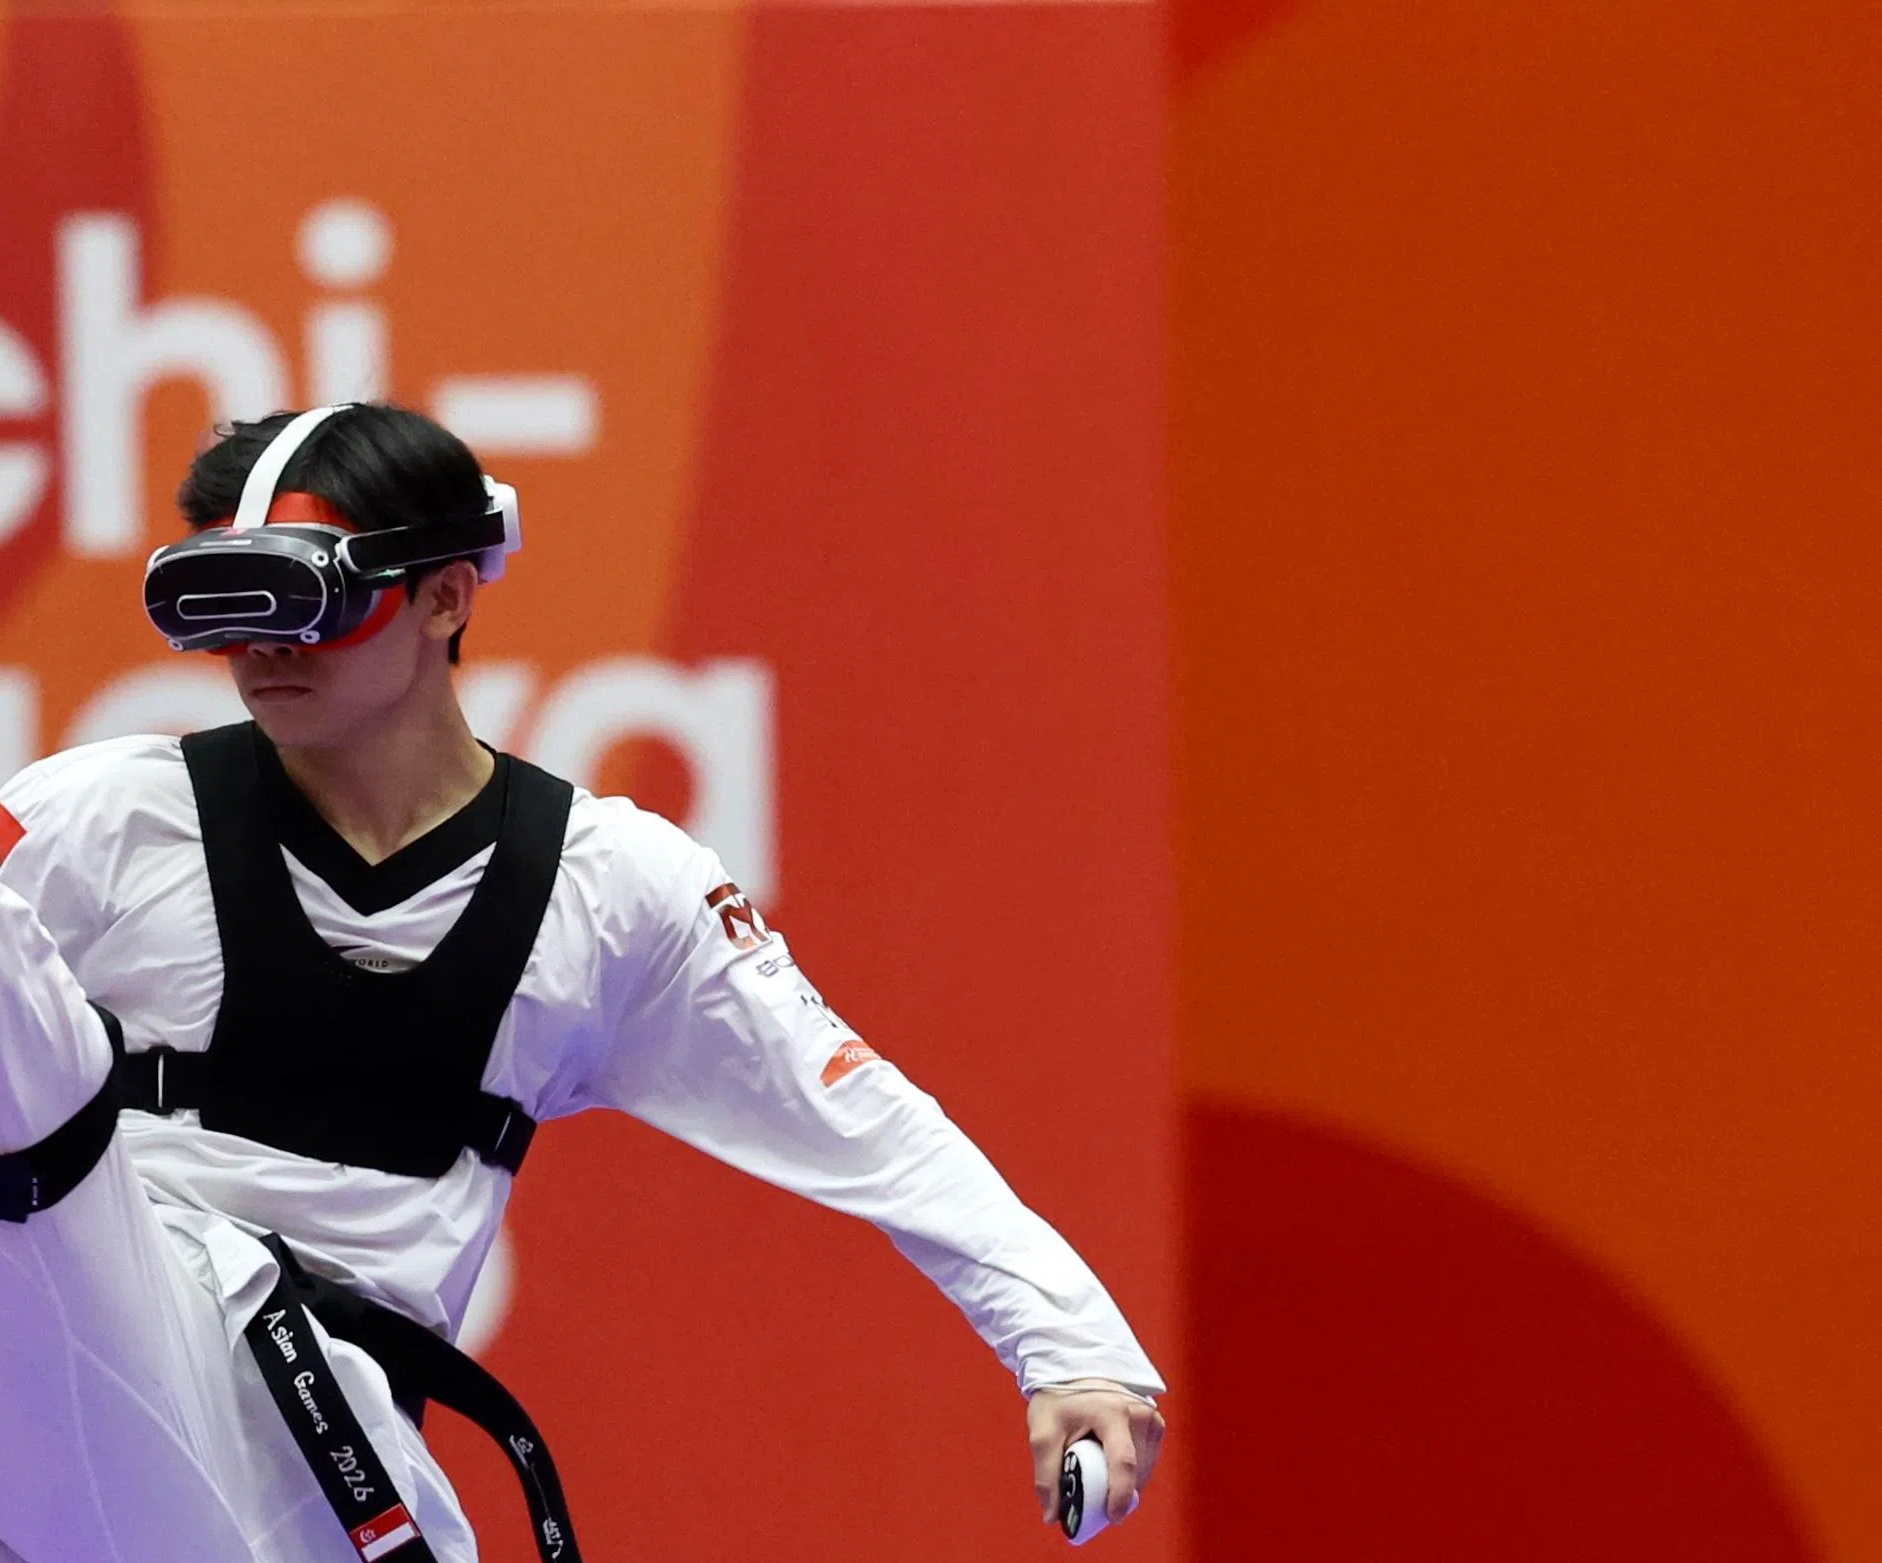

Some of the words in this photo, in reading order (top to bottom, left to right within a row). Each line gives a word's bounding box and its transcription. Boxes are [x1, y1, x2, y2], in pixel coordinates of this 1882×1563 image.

[262, 1308, 298, 1364] Asian
[293, 1370, 329, 1435] Games
[329, 1445, 375, 1502] 2026
